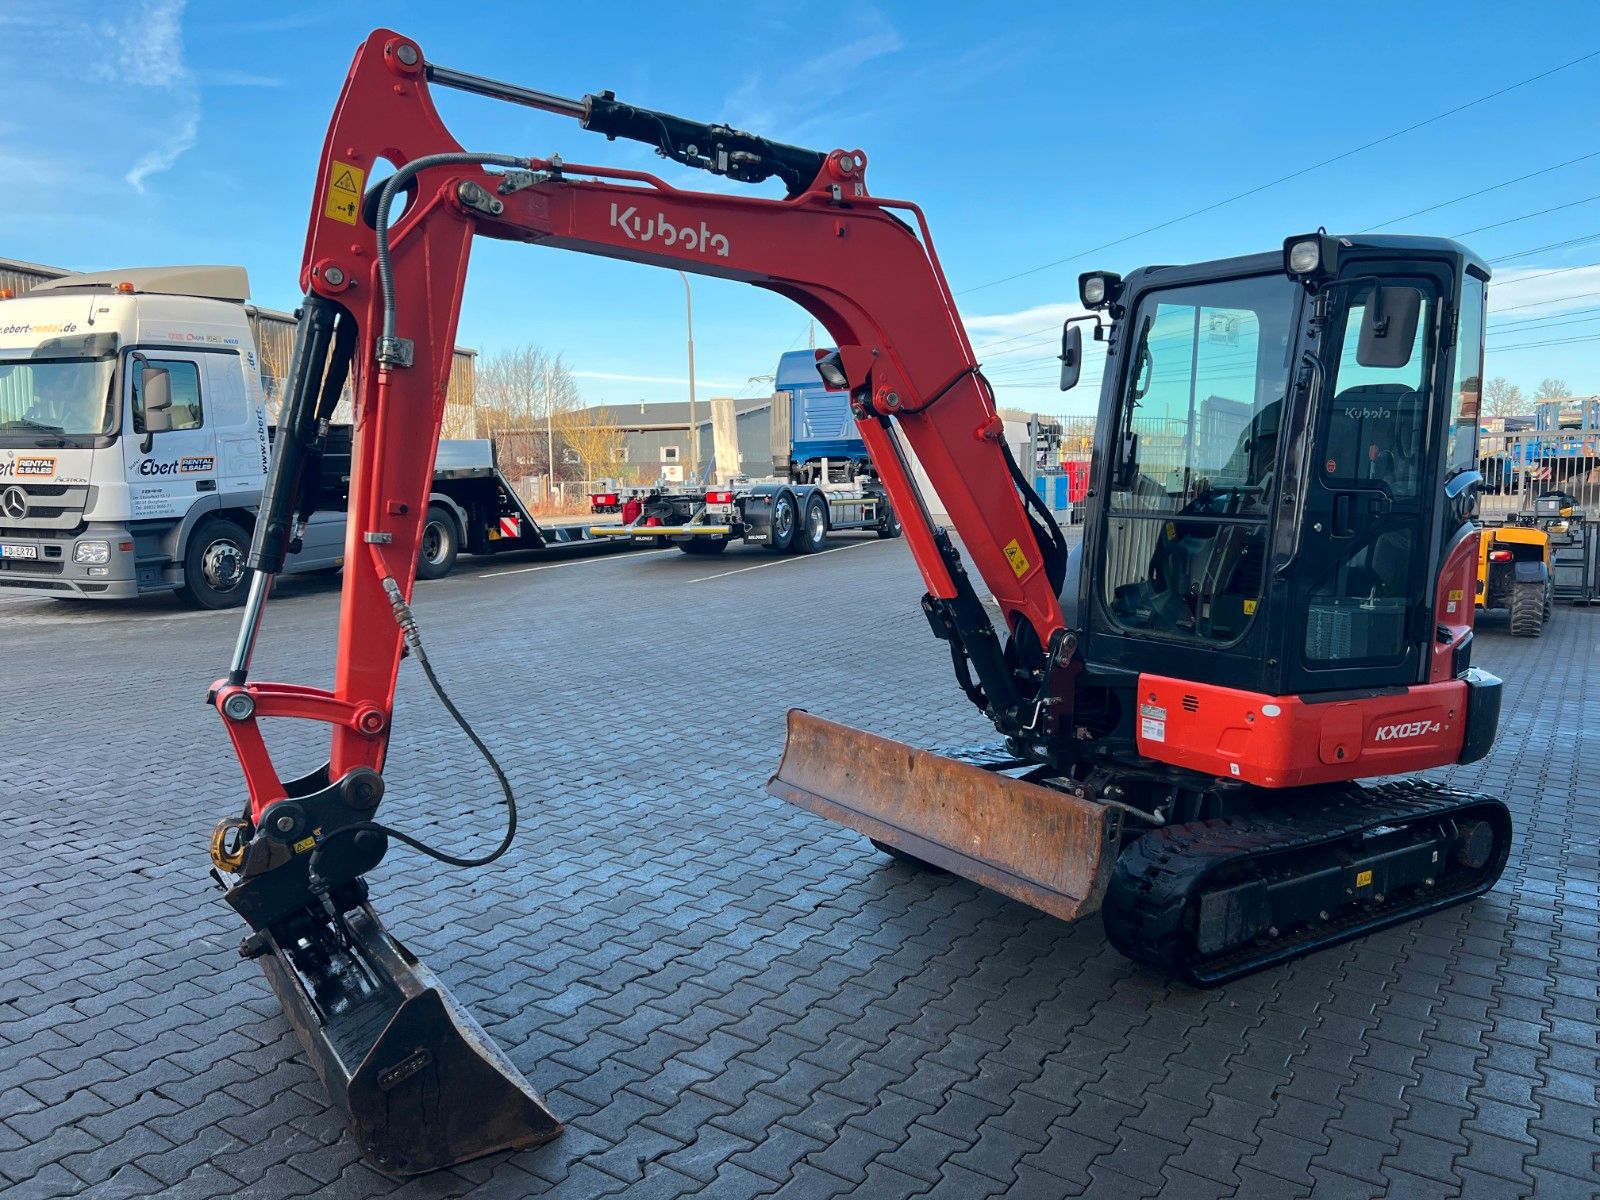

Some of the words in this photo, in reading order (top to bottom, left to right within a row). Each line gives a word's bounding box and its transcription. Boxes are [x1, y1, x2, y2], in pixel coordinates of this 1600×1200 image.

[611, 203, 729, 257] Kubota
[1344, 406, 1391, 419] Kubota
[140, 458, 179, 476] Ebert
[1375, 720, 1440, 741] KX037-4
